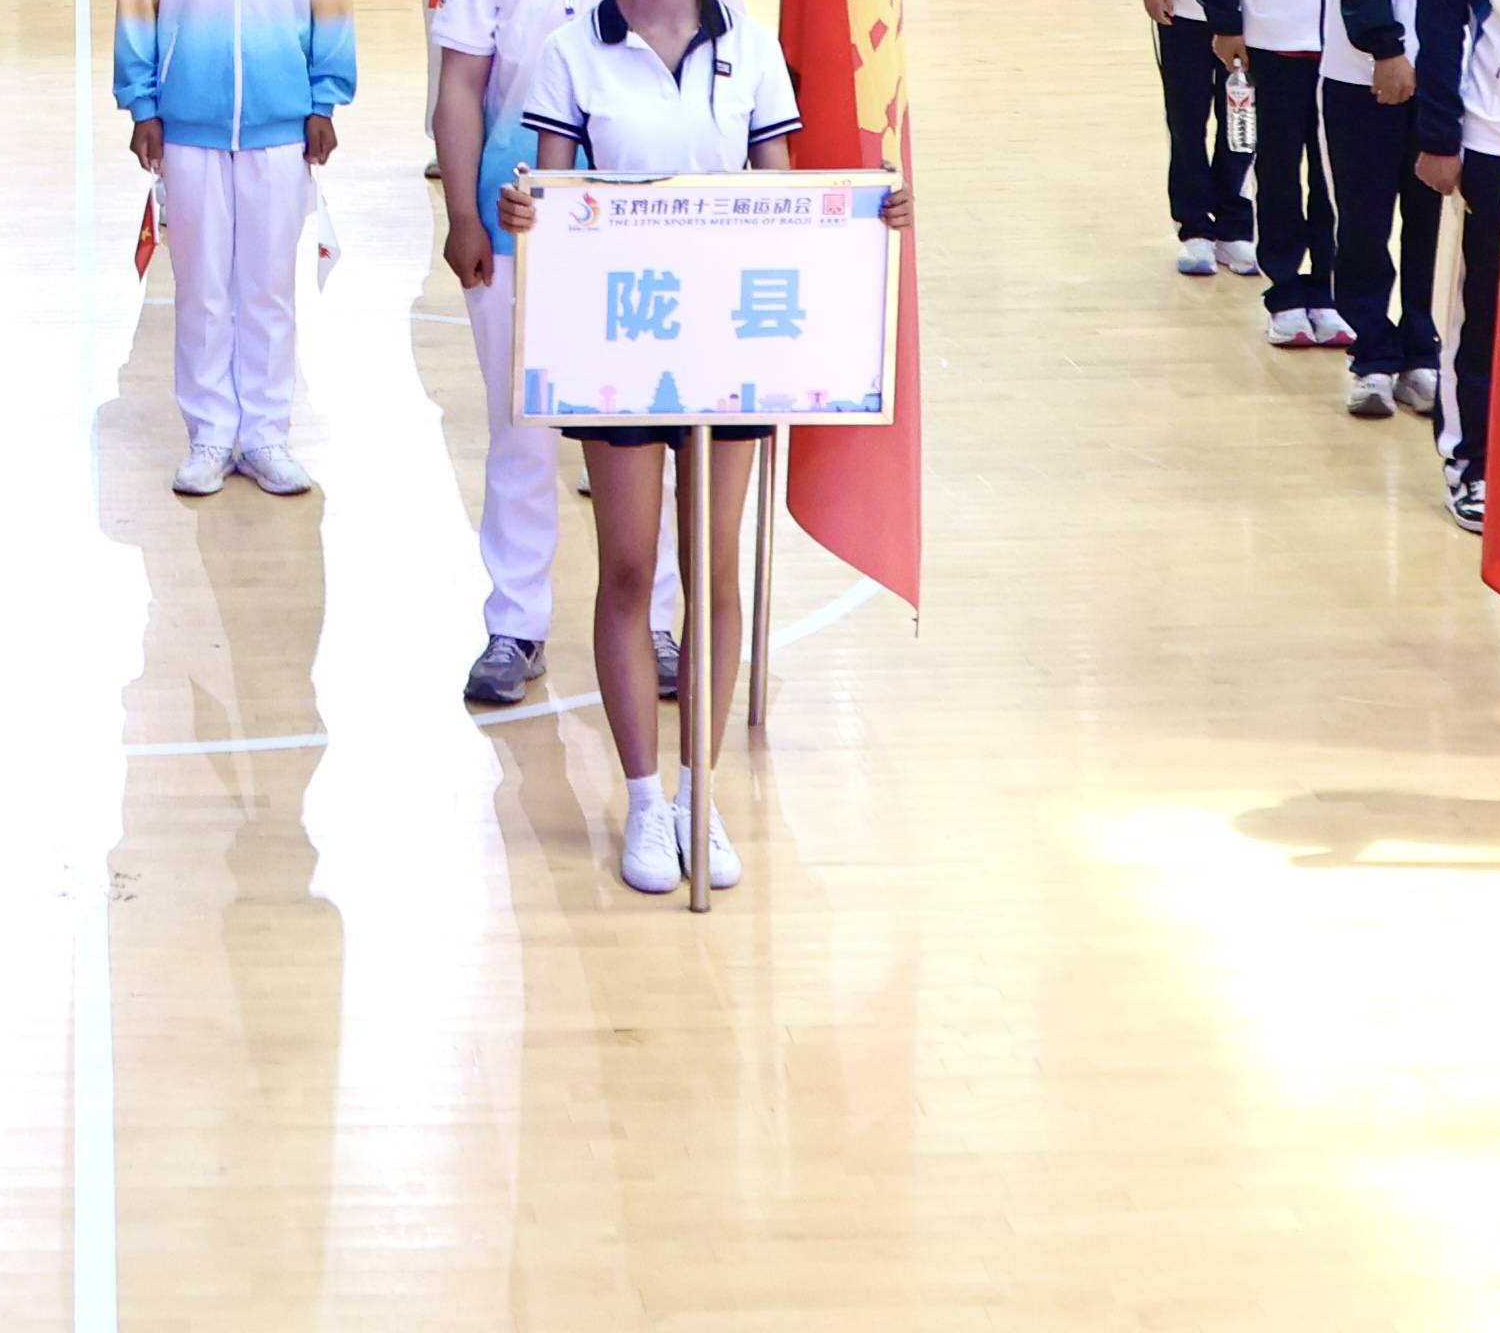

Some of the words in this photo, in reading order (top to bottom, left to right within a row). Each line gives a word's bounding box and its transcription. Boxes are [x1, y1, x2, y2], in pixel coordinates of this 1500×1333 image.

[609, 197, 812, 216] 宝鸡市第十三届运动会
[609, 219, 630, 227] THE
[664, 219, 707, 227] SPORTS
[710, 218, 758, 226] MEETING
[762, 218, 776, 226] OF
[606, 269, 806, 342] 陇县
